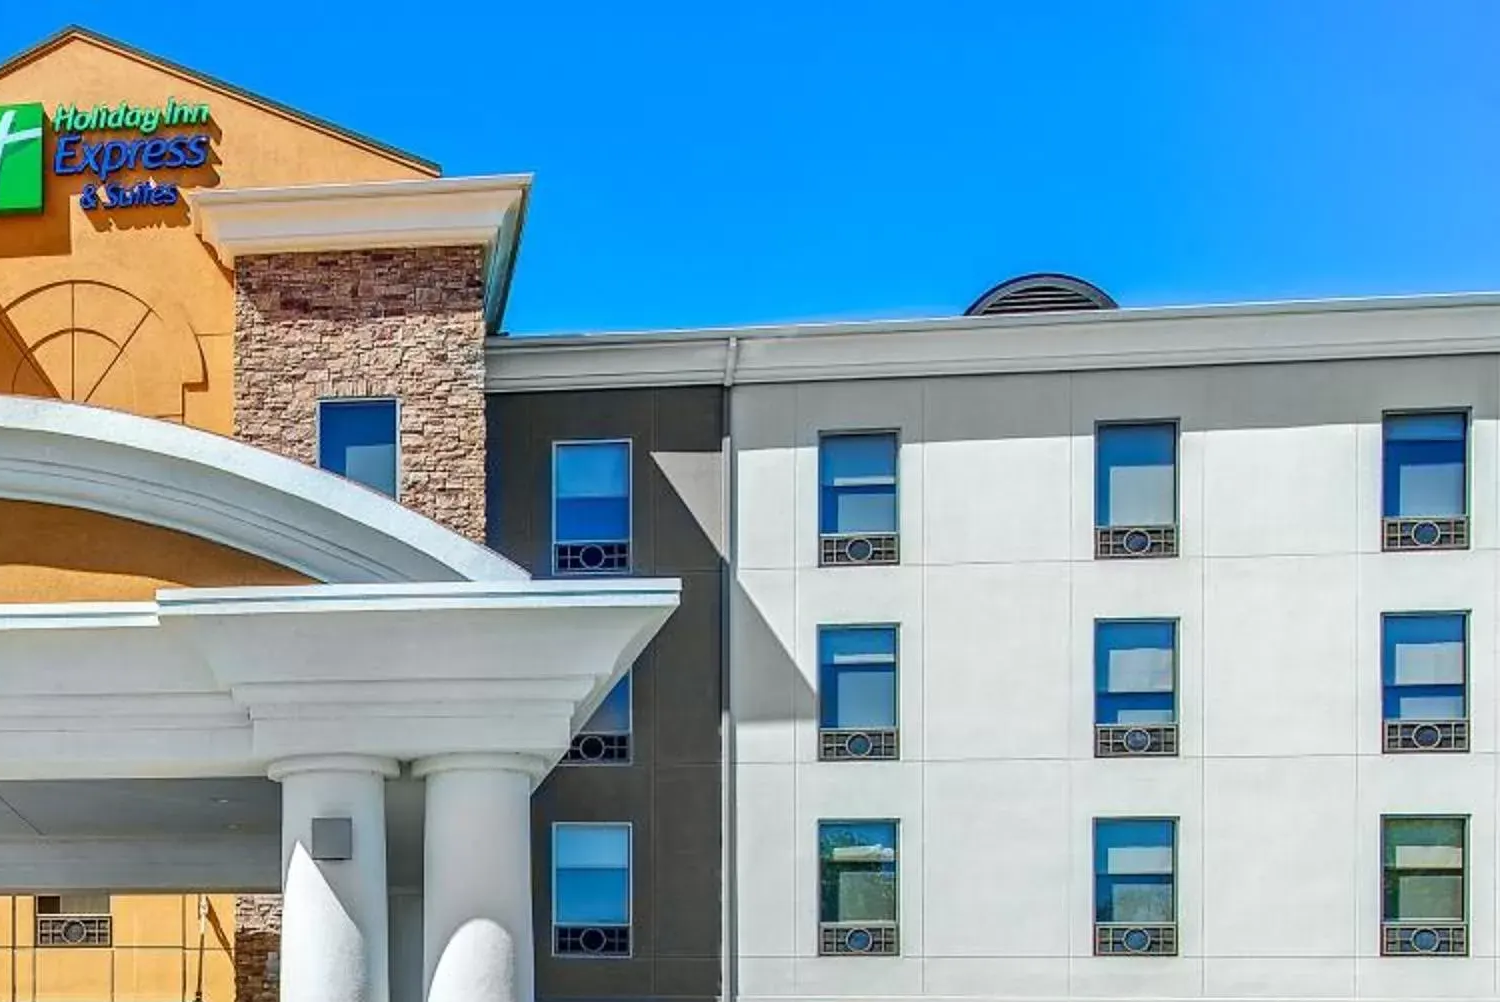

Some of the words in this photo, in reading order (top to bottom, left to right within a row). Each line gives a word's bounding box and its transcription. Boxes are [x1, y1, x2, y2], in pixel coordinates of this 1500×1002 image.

[53, 101, 162, 133] Holiday
[164, 97, 210, 126] Inn
[53, 132, 210, 183] Express
[79, 184, 98, 210] &
[102, 182, 179, 209] Suites
